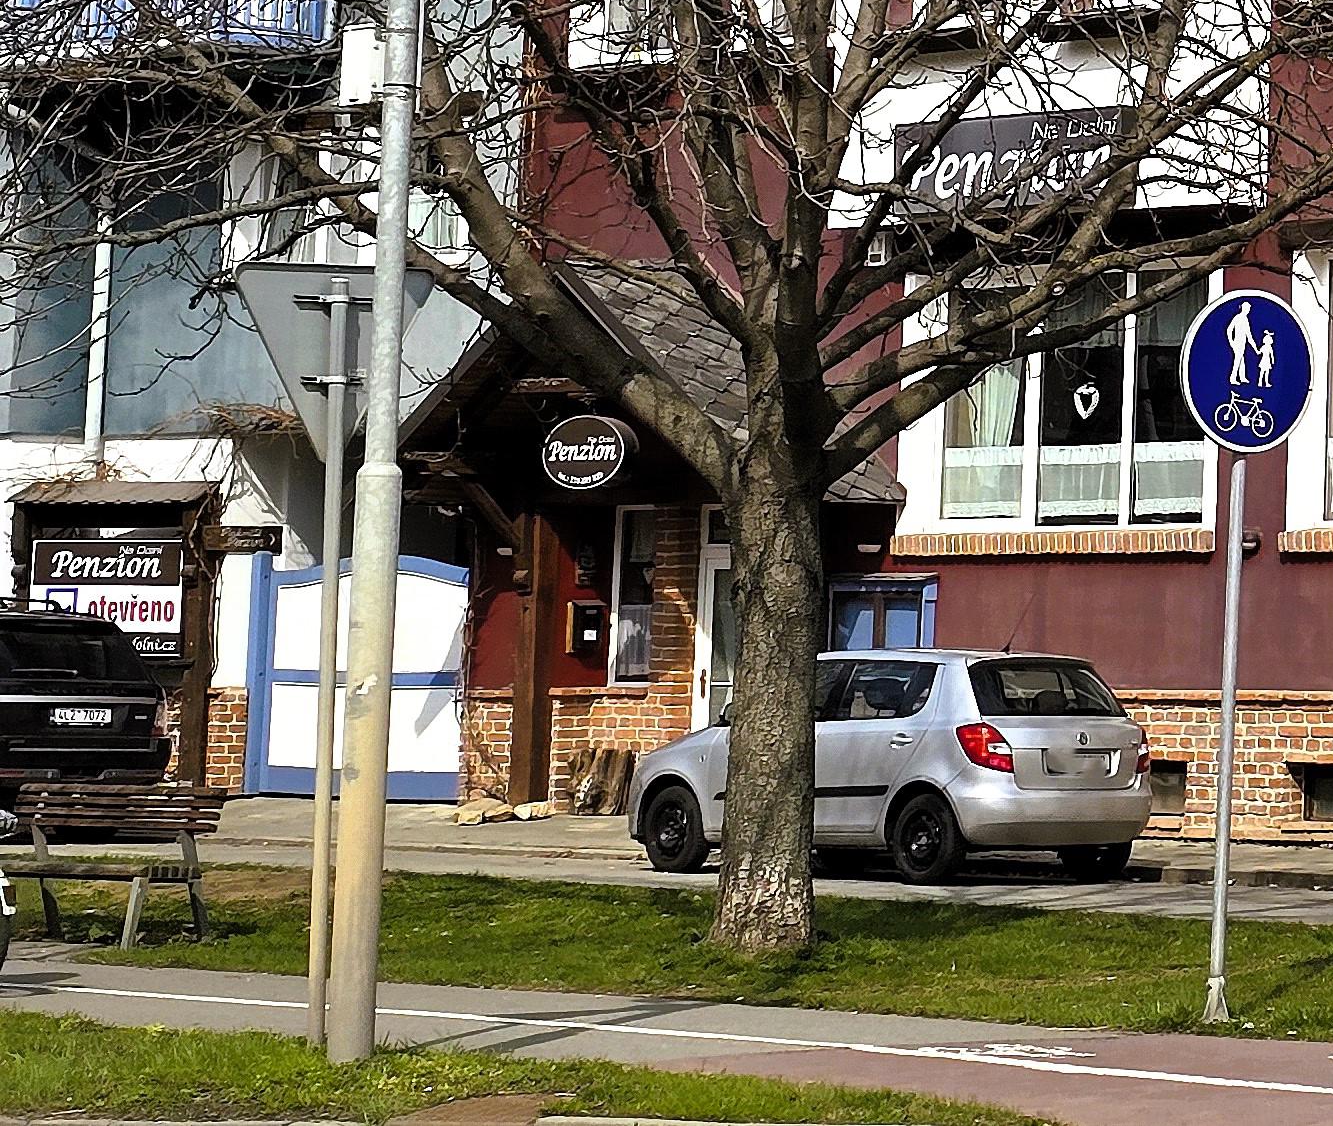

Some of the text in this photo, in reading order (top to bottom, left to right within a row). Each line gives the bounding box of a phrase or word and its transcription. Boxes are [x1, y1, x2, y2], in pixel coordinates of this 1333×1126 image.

[1030, 121, 1059, 140] Na
[548, 440, 618, 462] Penzion
[50, 550, 162, 579] Penzion
[88, 593, 175, 623] otevřeno
